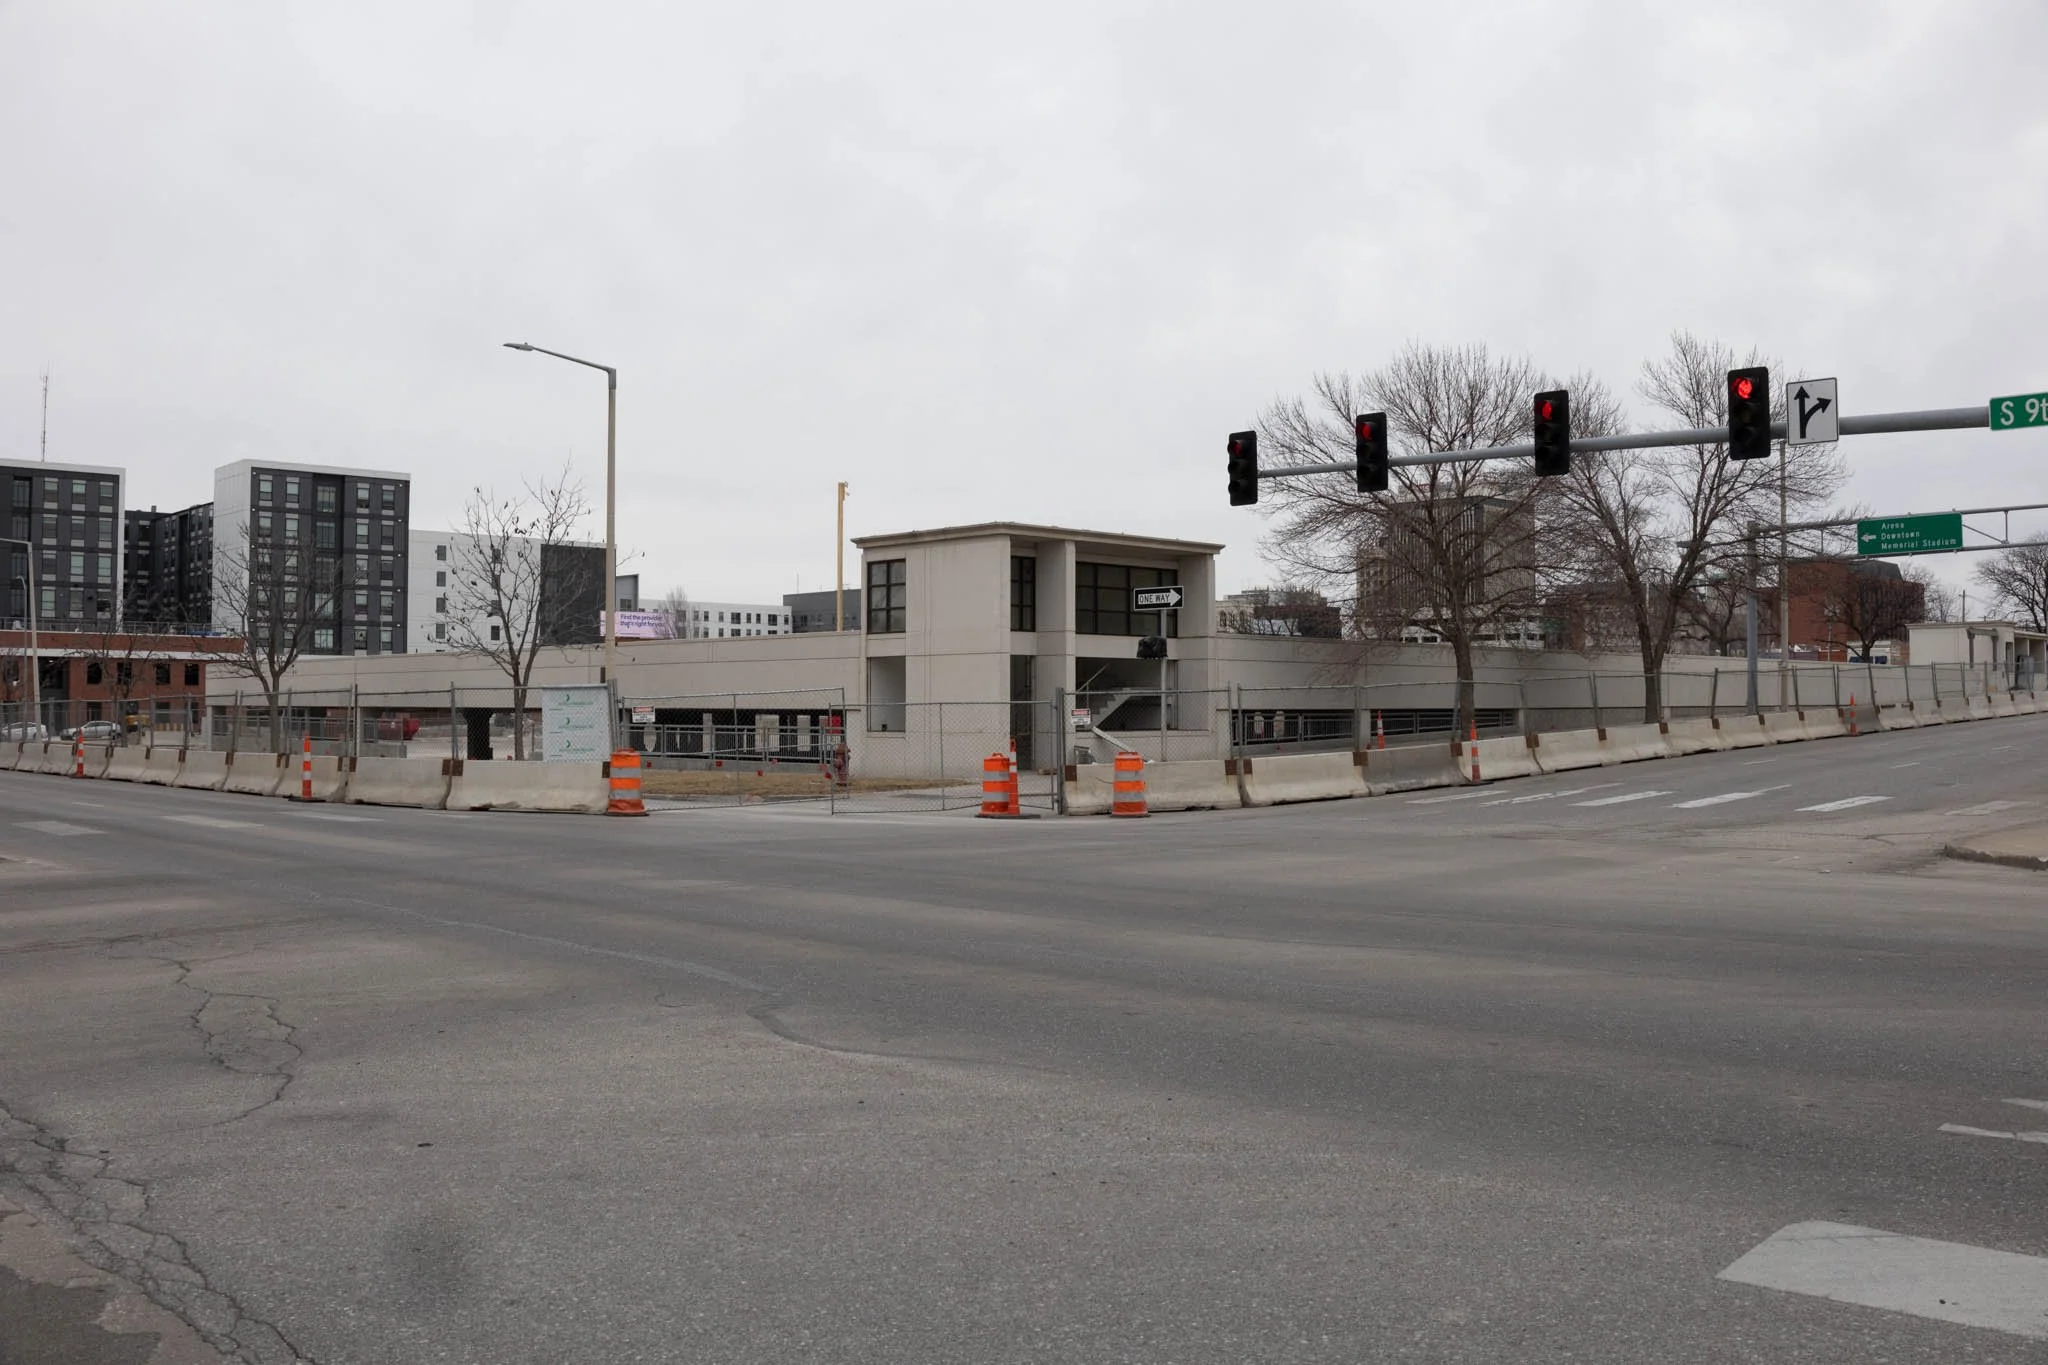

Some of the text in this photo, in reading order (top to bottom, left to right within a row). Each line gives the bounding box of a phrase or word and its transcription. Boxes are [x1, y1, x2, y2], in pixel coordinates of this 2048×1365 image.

[2000, 400, 2015, 426] S
[1881, 522, 1905, 530] Arena
[1881, 531, 1920, 540] Downtown
[1881, 538, 1957, 550] Memorial Stadium
[1139, 593, 1170, 603] ONE WAY
